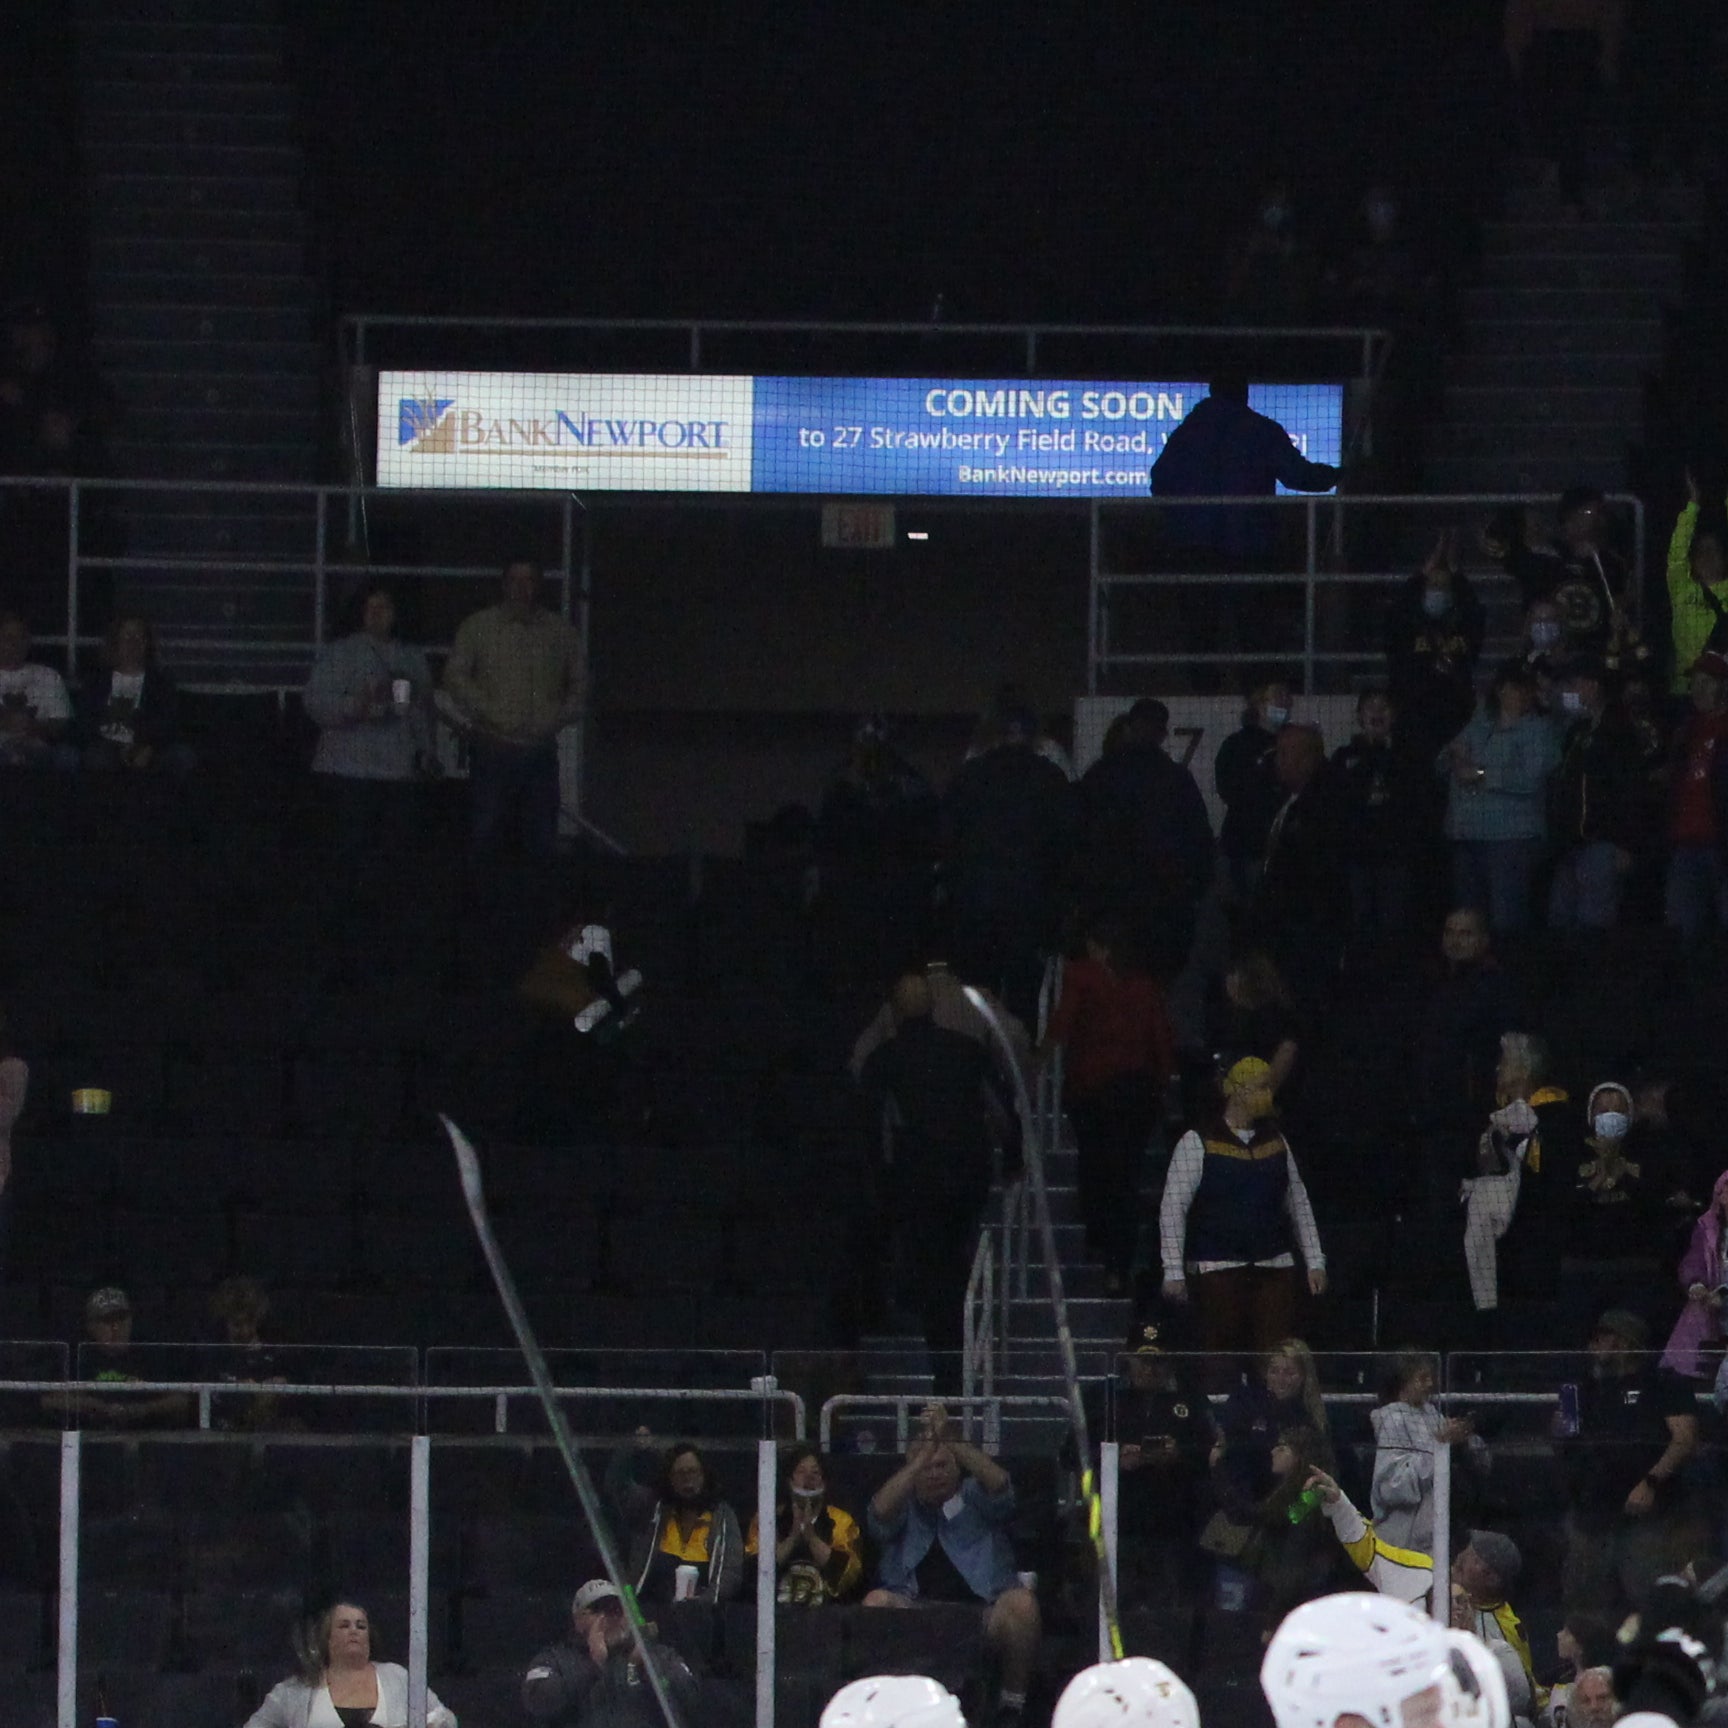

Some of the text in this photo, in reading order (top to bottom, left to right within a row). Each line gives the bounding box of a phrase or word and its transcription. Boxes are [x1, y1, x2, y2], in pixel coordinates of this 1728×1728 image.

[924, 388, 1184, 421] COMING SOON
[798, 425, 825, 449] to
[833, 426, 863, 449] 27
[869, 425, 1010, 457] Strawberry
[1018, 427, 1075, 452] Field
[1083, 429, 1154, 456] Road,
[958, 464, 1149, 487] BankNewport.com
